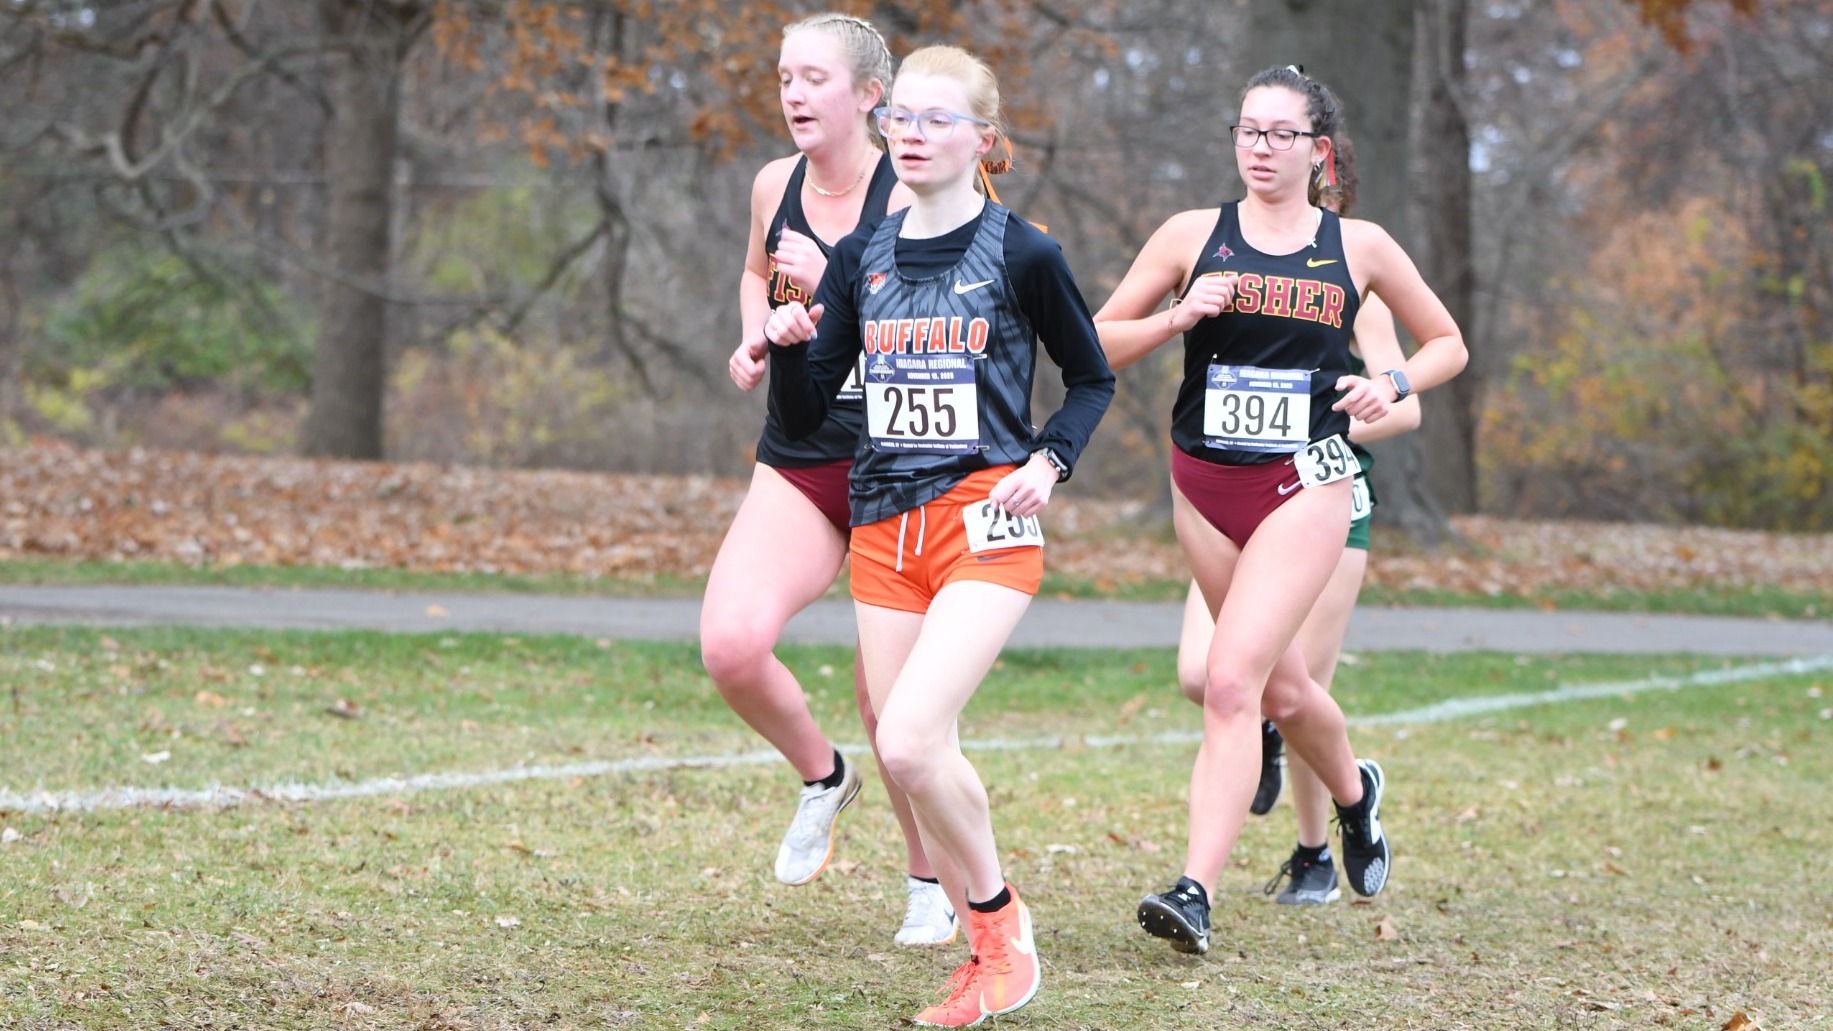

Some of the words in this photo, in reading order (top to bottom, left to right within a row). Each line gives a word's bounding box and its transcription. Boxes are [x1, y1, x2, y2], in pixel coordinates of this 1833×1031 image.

[1200, 271, 1345, 329] SHER
[864, 316, 989, 355] BUFFALO
[929, 358, 967, 369] REGIONAL
[884, 386, 956, 437] 255
[1222, 394, 1291, 437] 394
[1307, 438, 1358, 481] 394
